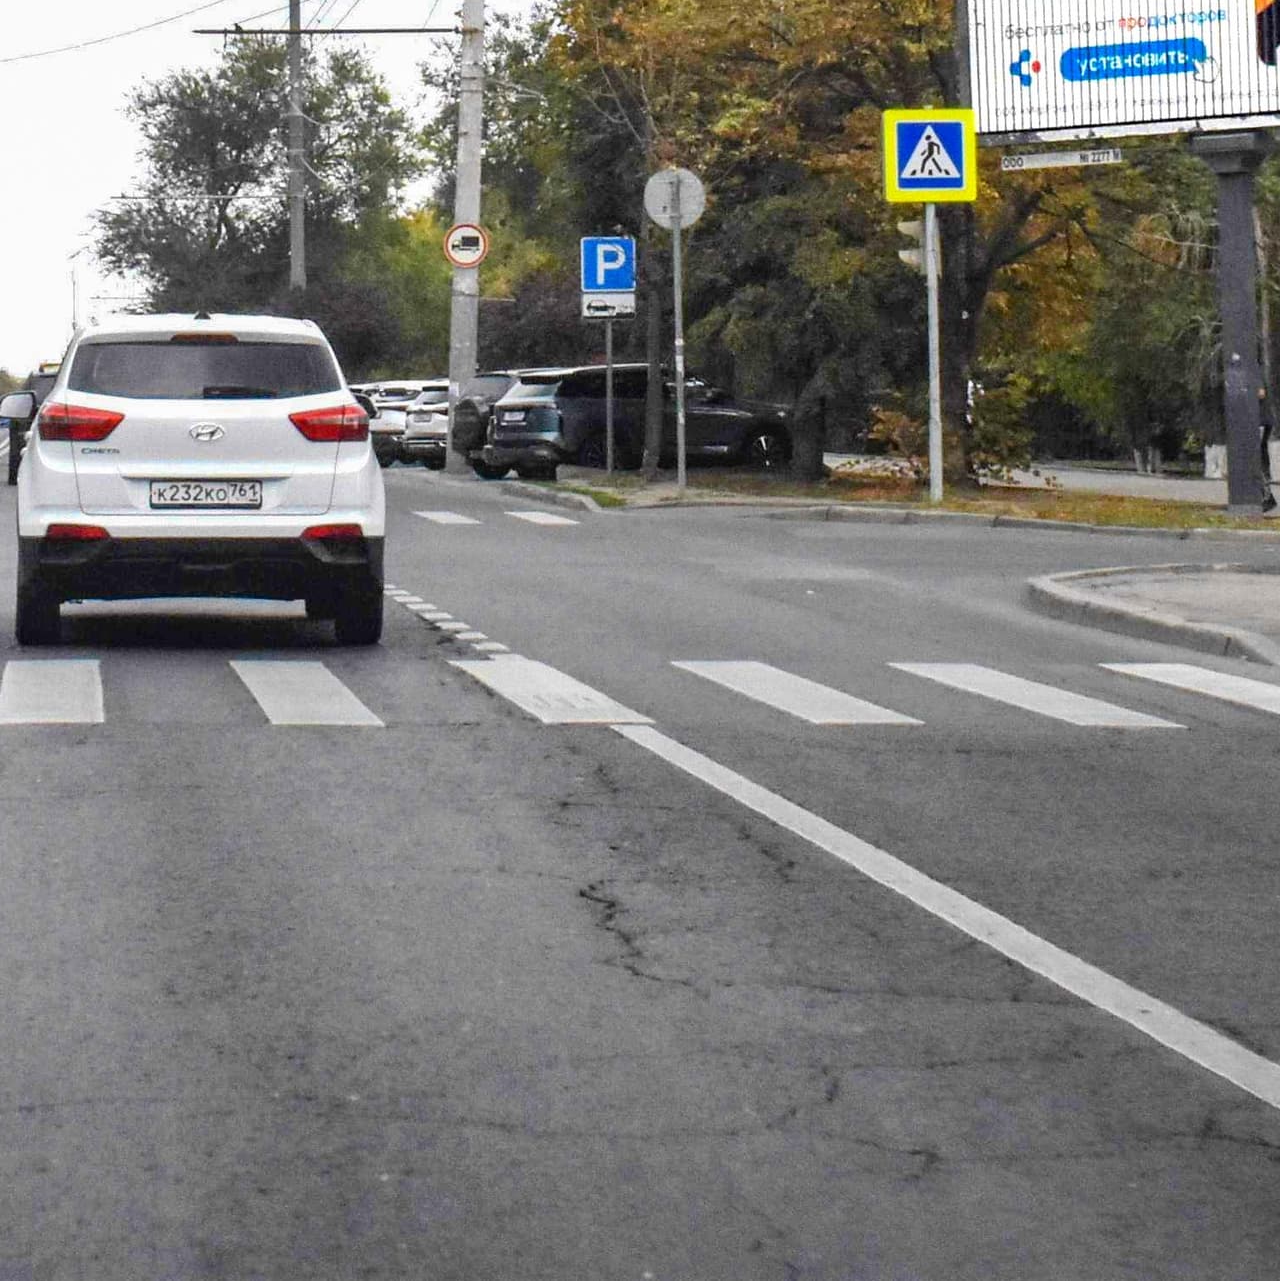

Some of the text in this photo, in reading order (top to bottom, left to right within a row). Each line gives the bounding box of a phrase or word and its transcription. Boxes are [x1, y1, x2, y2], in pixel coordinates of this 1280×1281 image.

[1004, 21, 1091, 40] бесплатно
[1118, 9, 1227, 31] продокторов
[1076, 51, 1189, 76] установить
